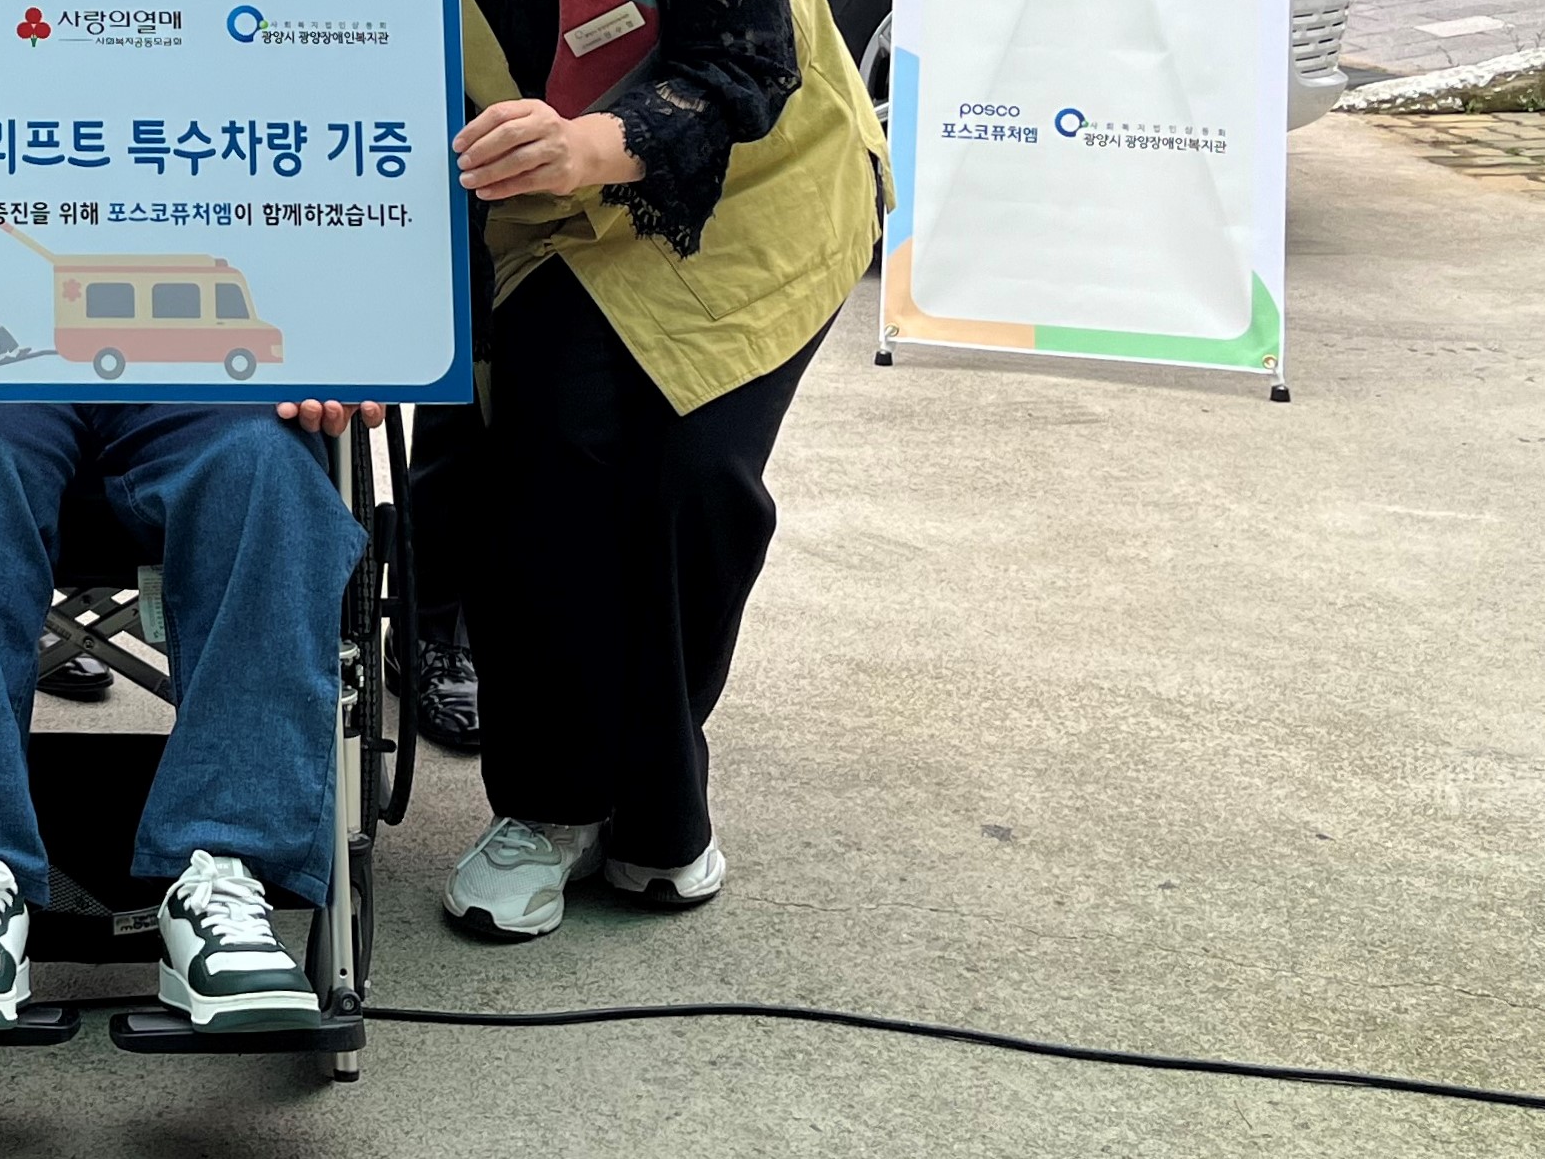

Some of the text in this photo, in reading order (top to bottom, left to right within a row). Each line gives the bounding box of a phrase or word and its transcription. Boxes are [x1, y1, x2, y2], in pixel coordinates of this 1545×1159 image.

[57, 10, 183, 35] 사랑의열매
[261, 30, 389, 45] 광양시 광양장애인복지관
[959, 102, 1021, 118] posco
[941, 122, 1038, 144] 포스코퓨처엠
[1083, 133, 1227, 154] 광양시 광양장애인복지관
[127, 119, 308, 177] 특수차량
[327, 120, 412, 178] 기증
[58, 201, 100, 226] 위해
[107, 202, 253, 226] 포스코퓨처엠이
[262, 202, 413, 228] 함께하겠습니다.
